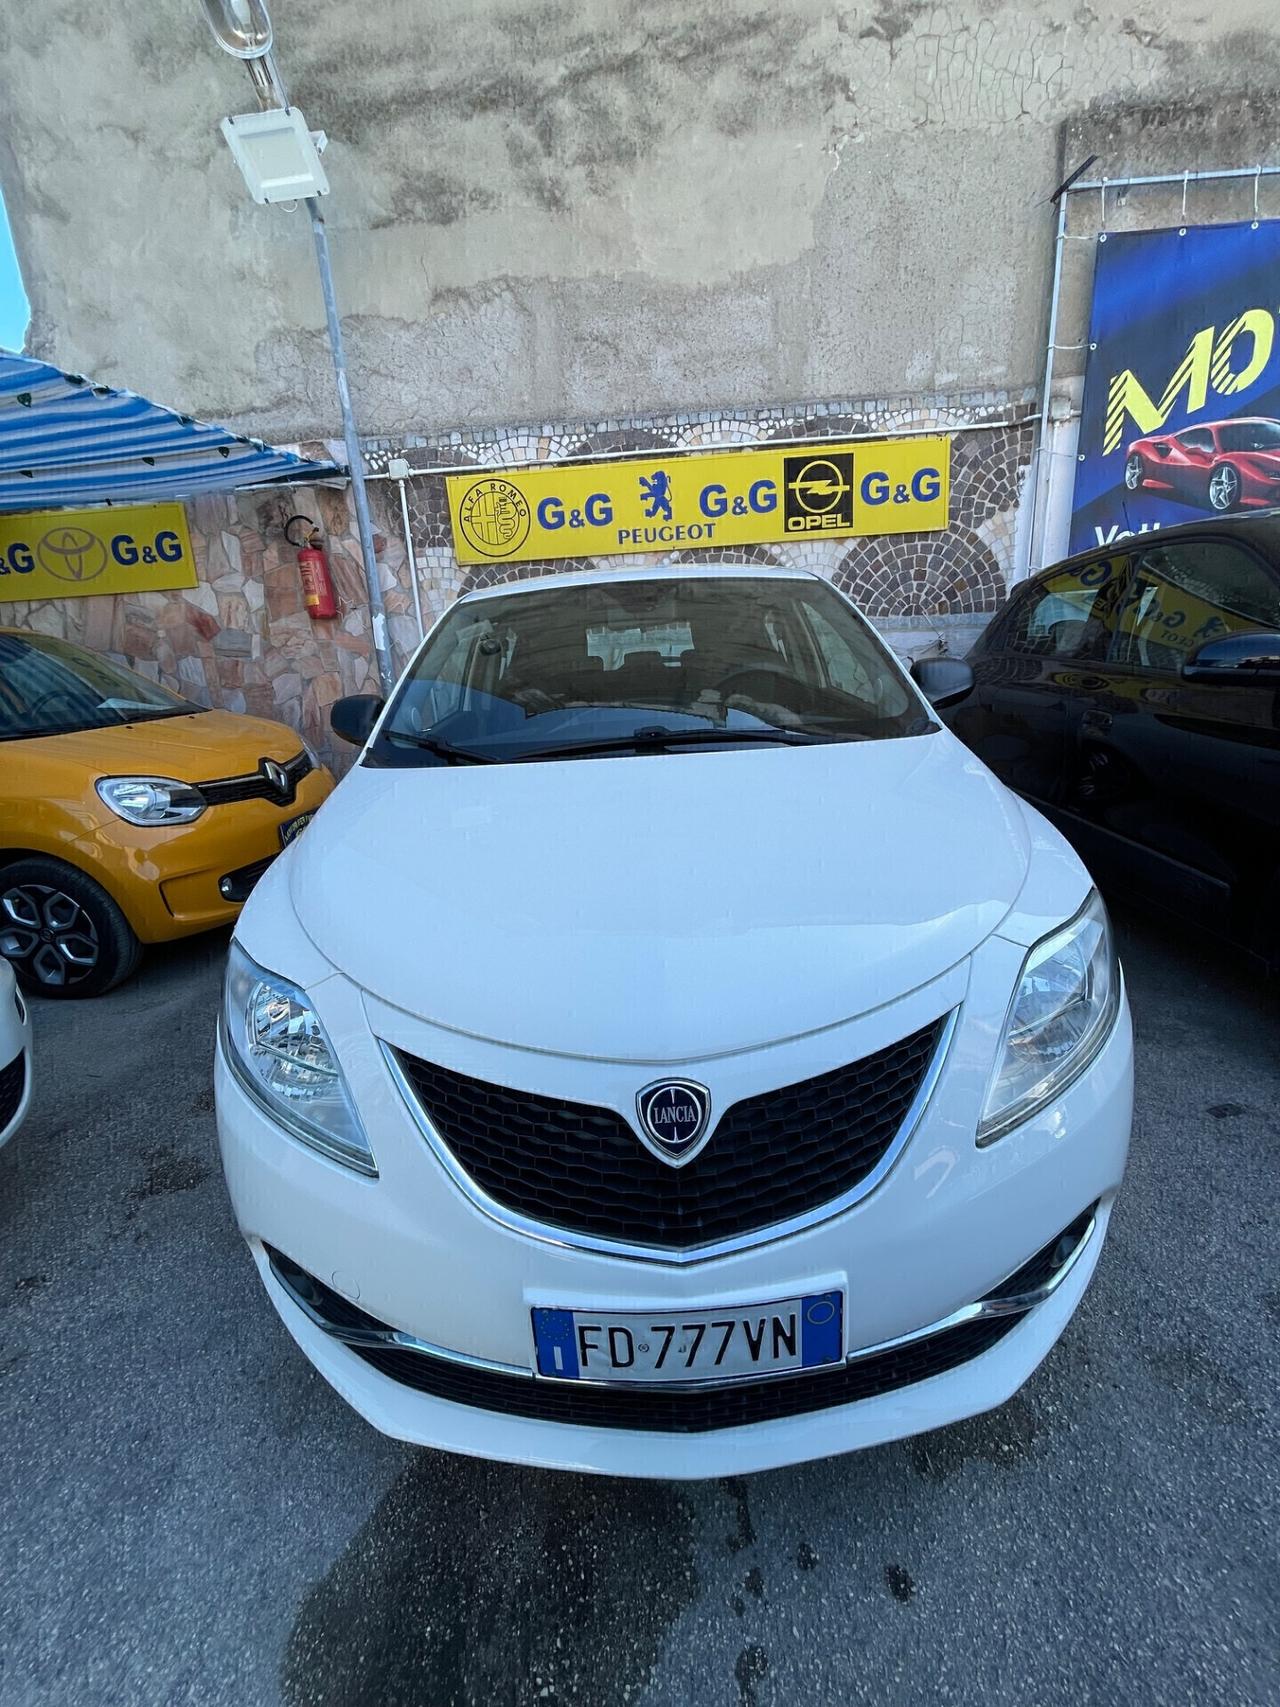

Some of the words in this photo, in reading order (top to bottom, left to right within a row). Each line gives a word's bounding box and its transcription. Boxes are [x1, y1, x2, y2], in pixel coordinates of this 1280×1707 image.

[463, 488, 483, 523] ALFA
[490, 482, 527, 517] ROMEO
[699, 479, 778, 518] G&G
[860, 467, 941, 506] G&G
[537, 493, 614, 531] G&G
[788, 513, 850, 531] OPEL
[111, 530, 184, 566] G&G
[618, 523, 716, 545] PEUGEOT
[653, 1105, 697, 1124] LANCIA
